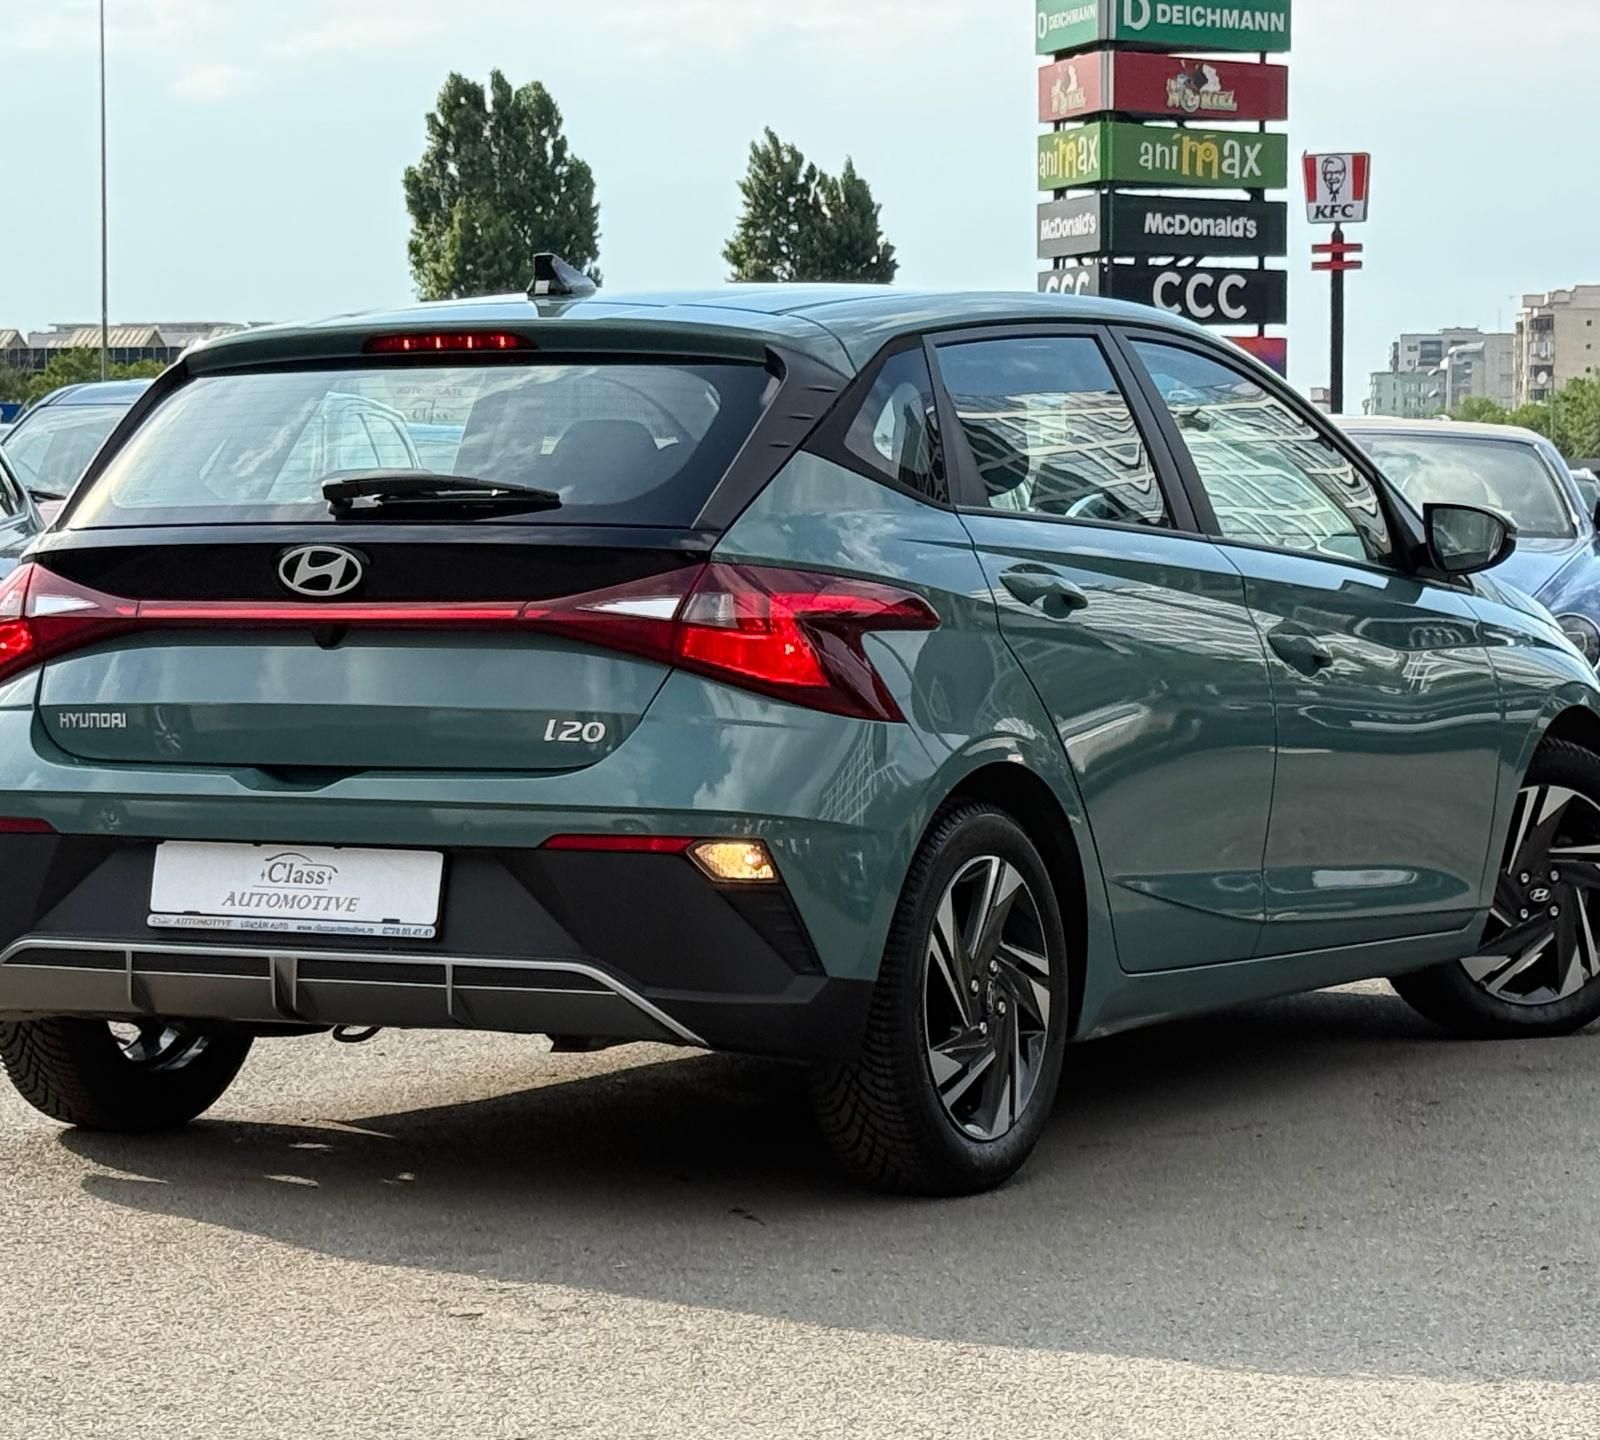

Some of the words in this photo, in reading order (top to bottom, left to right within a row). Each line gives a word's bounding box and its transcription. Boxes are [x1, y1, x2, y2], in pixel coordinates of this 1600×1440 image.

[1048, 3, 1097, 31] DEICHMANN
[1156, 3, 1286, 33] DEICHMANN
[1039, 133, 1098, 180] animax
[1139, 133, 1263, 180] animax
[1143, 211, 1258, 239] McDonald's
[1313, 203, 1354, 219] KFC
[1040, 212, 1097, 241] McDonald's
[1152, 271, 1248, 320] CCC
[58, 712, 127, 729] HYUNDAI
[267, 861, 327, 885] Class
[221, 890, 361, 912] AUTOMOTIVE
